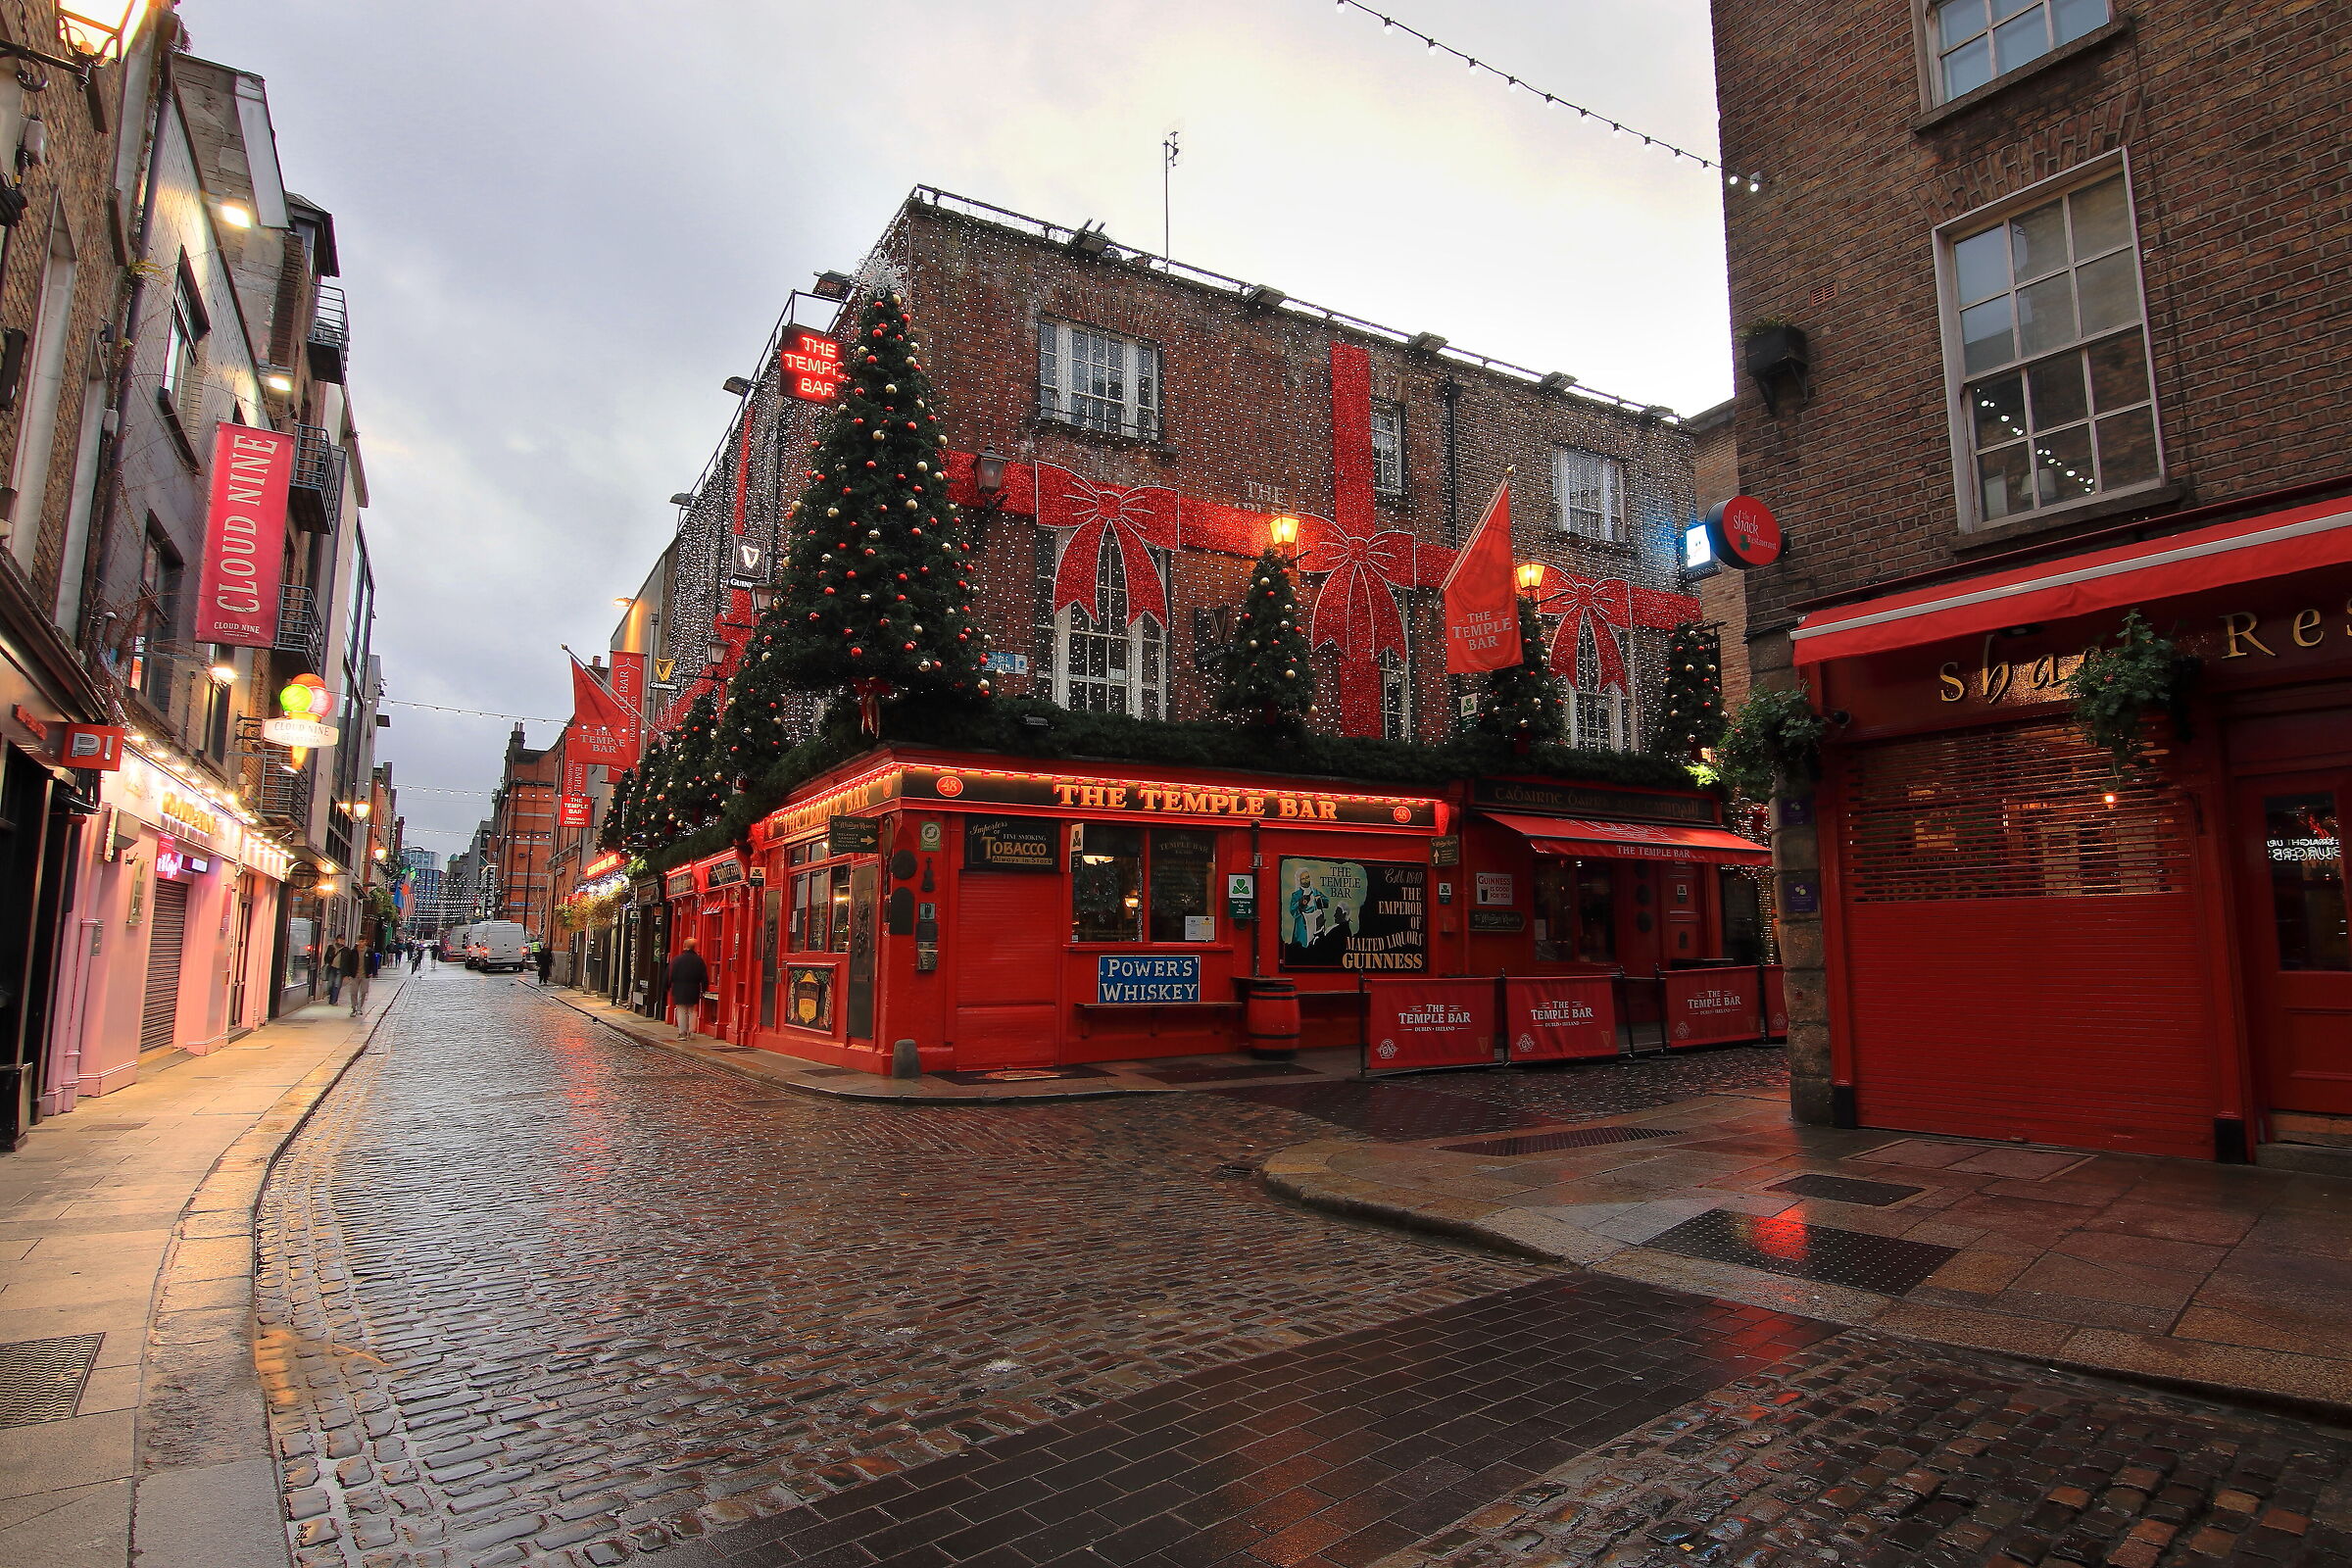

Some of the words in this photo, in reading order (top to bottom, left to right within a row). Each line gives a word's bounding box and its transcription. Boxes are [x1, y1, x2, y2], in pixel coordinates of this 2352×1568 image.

[802, 337, 836, 358] THE
[785, 354, 838, 376] TEMP
[801, 377, 835, 398] BAR
[227, 434, 278, 506] NINE
[1245, 480, 1288, 505] THE
[217, 514, 261, 613] CLOUD
[730, 578, 753, 588] GUINN
[1467, 612, 1492, 623] THE
[214, 621, 239, 630] CLOUD
[241, 624, 261, 634] NINE
[1452, 617, 1512, 638] TEMPLE
[1468, 636, 1499, 651] BAR
[1939, 629, 2130, 705] sha
[619, 670, 629, 693] BAR
[274, 721, 305, 731] CLOUD
[309, 724, 330, 736] NINE
[629, 707, 638, 742] TRADIN
[71, 732, 115, 760] PI
[592, 744, 616, 754] BAR
[942, 779, 958, 792] 48
[784, 812, 805, 834] THE
[805, 799, 842, 827] TEMPLE
[846, 785, 869, 812] BAR
[1054, 784, 1127, 808] THE
[1140, 789, 1265, 815] TEMPLE
[1279, 798, 1338, 820] BAR
[1396, 808, 1410, 821] 48
[981, 836, 1048, 859] TOBACCO
[1617, 845, 1635, 855] THE
[1638, 846, 1672, 858] TEMPLE
[1673, 848, 1690, 858] BAR
[1330, 867, 1350, 877] THE
[1320, 877, 1361, 889] TEMPLE
[1477, 876, 1510, 885] GUINNESS
[1331, 888, 1351, 900] BAR
[1401, 887, 1421, 901] THE
[1378, 901, 1422, 915] EMPEROR
[1411, 916, 1421, 930] OF
[1346, 936, 1385, 952] MALTED
[1386, 930, 1424, 950] LIQUORS
[1342, 953, 1423, 969] GUINNESS
[1102, 983, 1198, 1001] WHISKEY
[1688, 998, 1722, 1008] TEMPLE
[1724, 996, 1741, 1006] BAR
[1398, 1012, 1445, 1024] TEMPLE
[1447, 1011, 1471, 1023] BAR
[1531, 1009, 1569, 1020] TEMPLE
[1572, 1007, 1593, 1018] BAR
